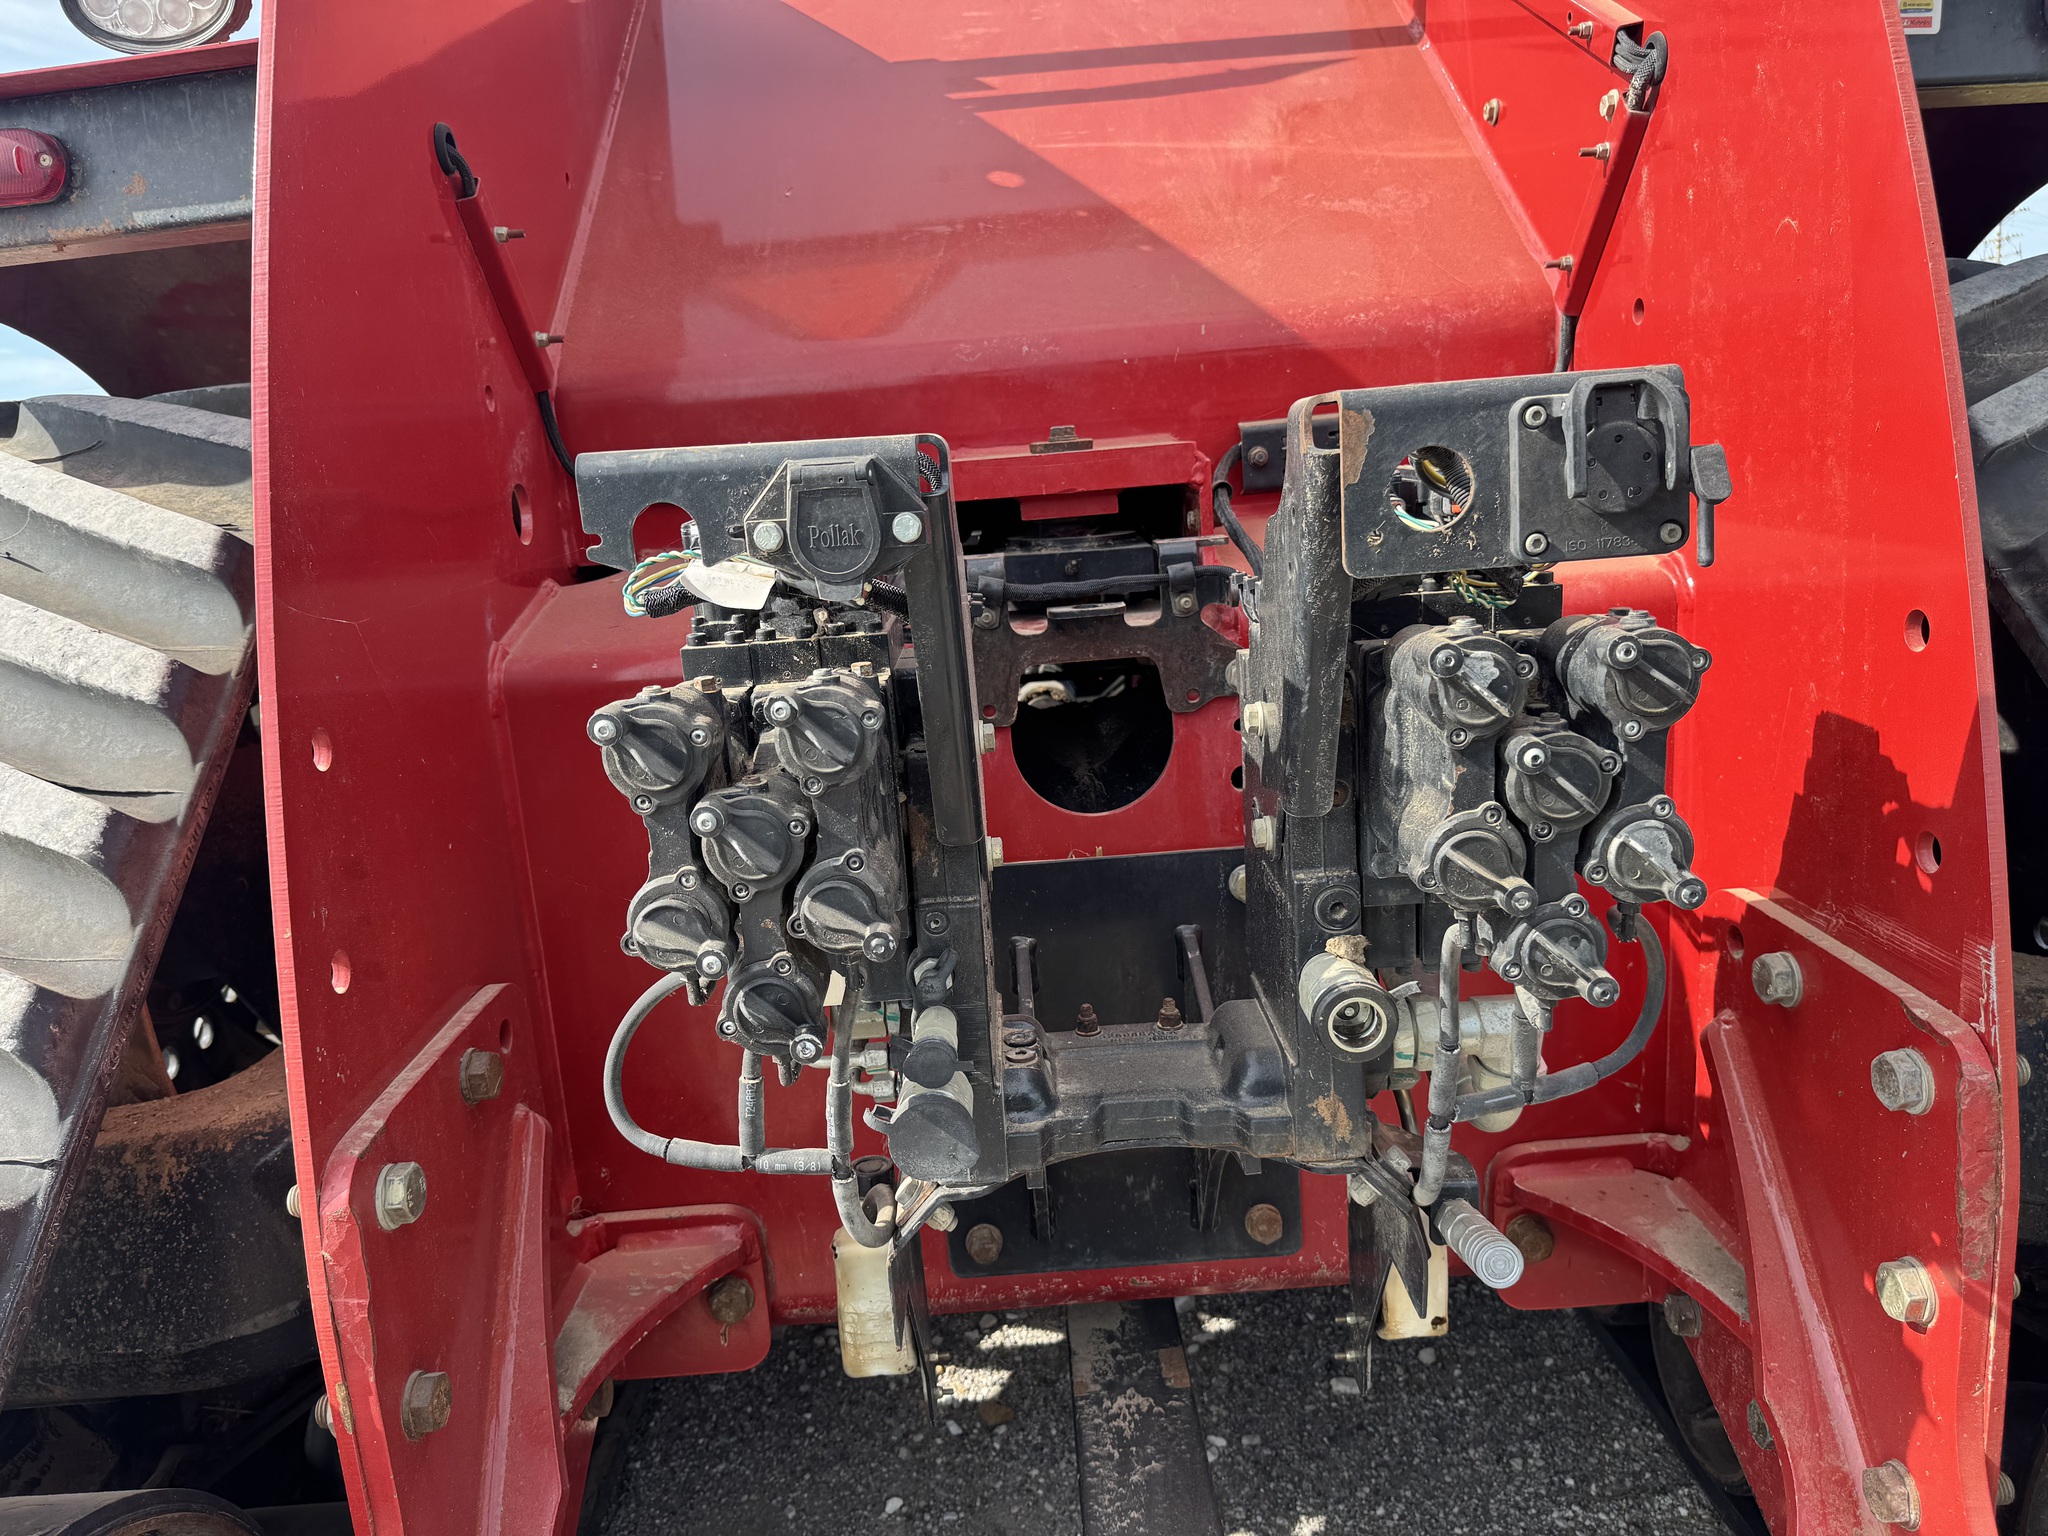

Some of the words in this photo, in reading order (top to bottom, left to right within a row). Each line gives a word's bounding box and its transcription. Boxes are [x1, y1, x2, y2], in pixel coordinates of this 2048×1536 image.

[807, 522, 862, 549] Pollak
[1565, 539, 1587, 552] ISO
[759, 1160, 769, 1170] 10
[774, 1163, 787, 1171] mm
[793, 1161, 821, 1172] (3/8)
